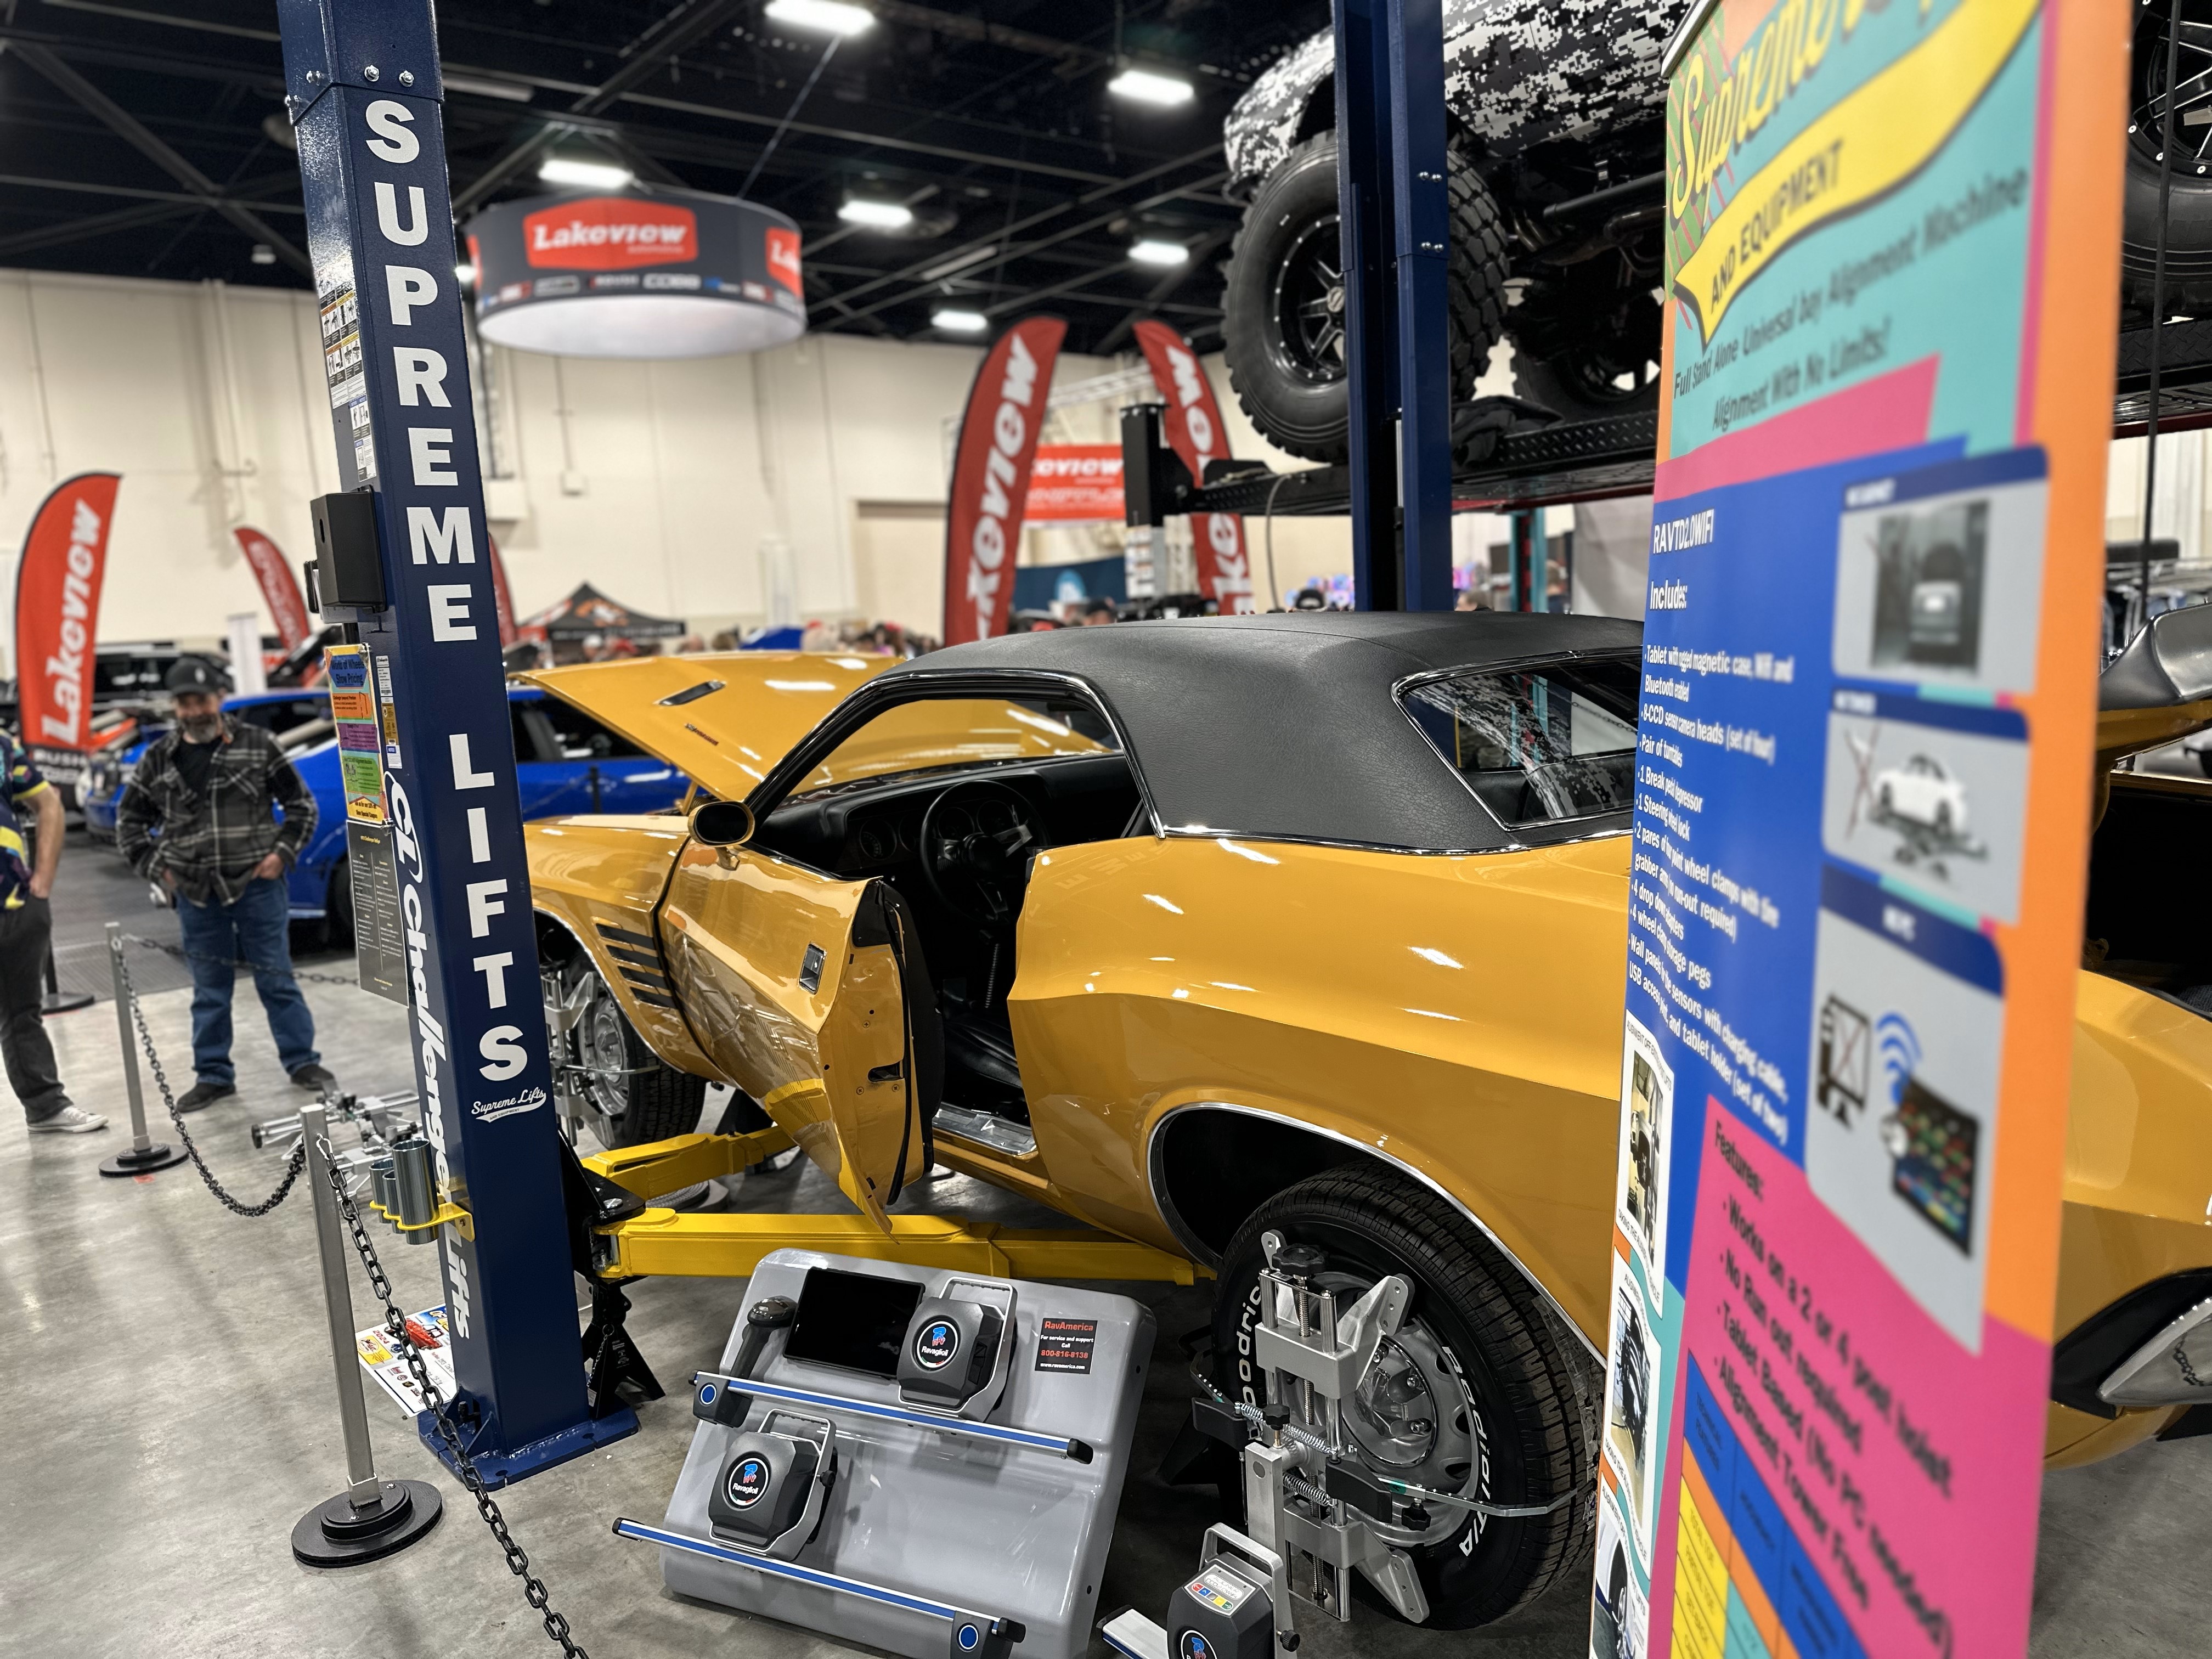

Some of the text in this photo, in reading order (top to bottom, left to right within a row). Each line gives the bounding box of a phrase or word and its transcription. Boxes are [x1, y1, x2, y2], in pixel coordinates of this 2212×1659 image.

[533, 220, 687, 251] Lakeview
[1710, 137, 1844, 313] AND EQUIPMENT
[1673, 366, 1692, 400] Full
[1692, 349, 1712, 385] Stand
[1712, 338, 1739, 371] Alone
[1827, 227, 1917, 308] Alignment
[1921, 167, 2028, 256] Machine
[365, 100, 477, 642] SUPREME
[1712, 379, 1769, 433] Alignment
[1771, 360, 1801, 404] With
[1804, 354, 1825, 388] No
[1653, 508, 1715, 554] RAVTD2.0WIFI
[1650, 578, 1688, 610] Includes:
[42, 497, 101, 745] Lakeview
[347, 673, 363, 686] Pricing
[1647, 644, 1667, 664] Tablet
[1693, 651, 1730, 676] magnetic
[1645, 674, 1674, 697] Bluetooth
[1641, 733, 1655, 754] Pair
[1656, 738, 1663, 757] of
[1643, 703, 1664, 725] 8-CCD
[1678, 716, 1695, 738] camera
[1697, 718, 1724, 744] heads
[1640, 764, 1644, 783] 1
[1646, 766, 1664, 791] Break
[1638, 792, 1643, 810] 1
[1644, 794, 1668, 827] Steering
[1678, 815, 1690, 842] lock
[1637, 821, 1641, 839] 2
[1641, 827, 1660, 849] pares
[1672, 848, 1683, 871] point
[1684, 857, 1709, 885] wheel
[1712, 869, 1739, 904] clamps
[449, 733, 528, 1081] LIFTS
[1633, 878, 1638, 896] 4
[1639, 882, 1654, 910] drop
[1635, 852, 1658, 878] grabber
[1674, 884, 1699, 915] run-out
[1700, 900, 1737, 944] required)
[1632, 903, 1637, 921] 4
[1638, 910, 1657, 935] wheel
[1666, 939, 1686, 973] storage
[1688, 960, 1711, 990] pegs
[1630, 933, 1644, 959] Wall
[1645, 947, 1662, 974] panels
[1672, 984, 1702, 1020] sensors
[1704, 1007, 1722, 1037] with
[1722, 1022, 1758, 1078] charging
[1629, 960, 1642, 986] USB
[1643, 976, 1660, 1007] access
[1669, 1014, 1681, 1038] and
[1683, 1025, 1709, 1060] tablet
[1711, 1044, 1733, 1086] holder
[1733, 1070, 1752, 1108] (set
[471, 1086, 545, 1114] Supreme Lifts
[1714, 1119, 1764, 1203] Features:
[444, 1222, 471, 1340] Lifts
[1725, 1247, 1741, 1290] No
[1728, 1193, 1764, 1263] Works
[1788, 1278, 1797, 1305] a
[1801, 1286, 1813, 1323] 2
[1837, 1330, 1849, 1368] 4
[373, 1330, 391, 1344] 2024
[922, 1345, 949, 1356] Ravaglioli
[1045, 1321, 1094, 1331] RavAmerica
[1723, 1299, 1757, 1376] Tablet
[1041, 1350, 1088, 1358] 800-816-8138
[1442, 1346, 1491, 1500] Radial
[1719, 1355, 1780, 1473] Alignment
[732, 1482, 759, 1494] Ravaglioli
